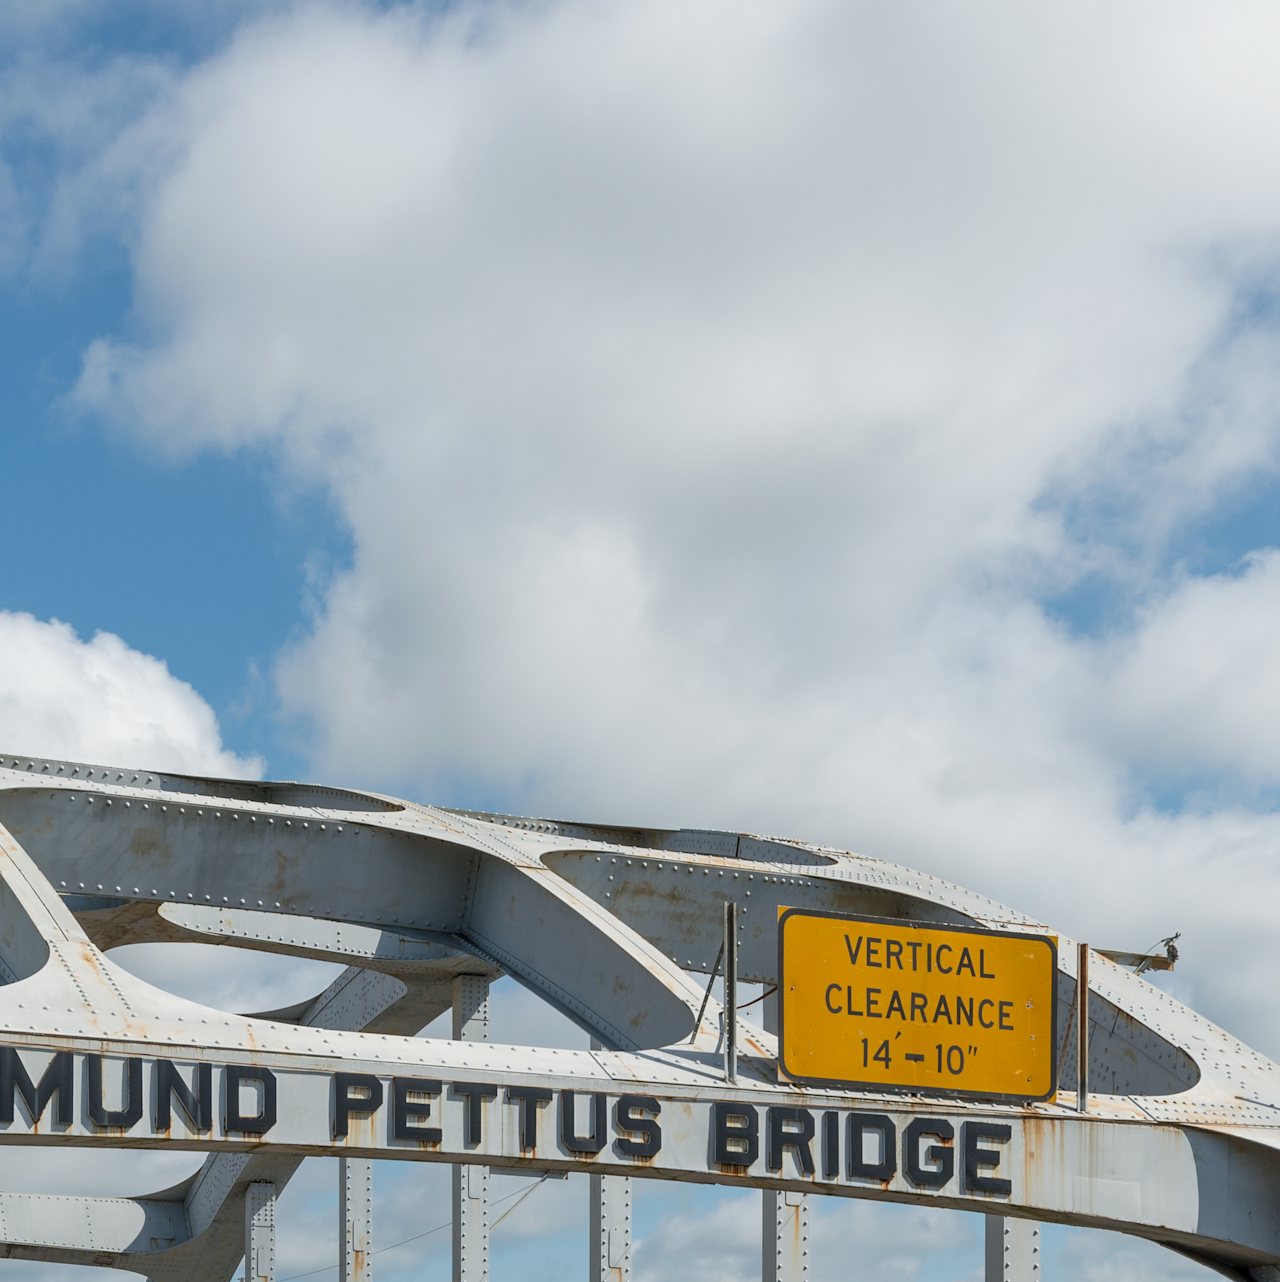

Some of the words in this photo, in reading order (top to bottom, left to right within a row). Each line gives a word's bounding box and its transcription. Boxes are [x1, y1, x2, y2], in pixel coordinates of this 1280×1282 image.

[844, 934, 995, 979] VERTICAL
[825, 983, 1014, 1031] CLEARANCE
[334, 1072, 662, 1158] PETTUS
[714, 1102, 1012, 1195] BRIDGE
